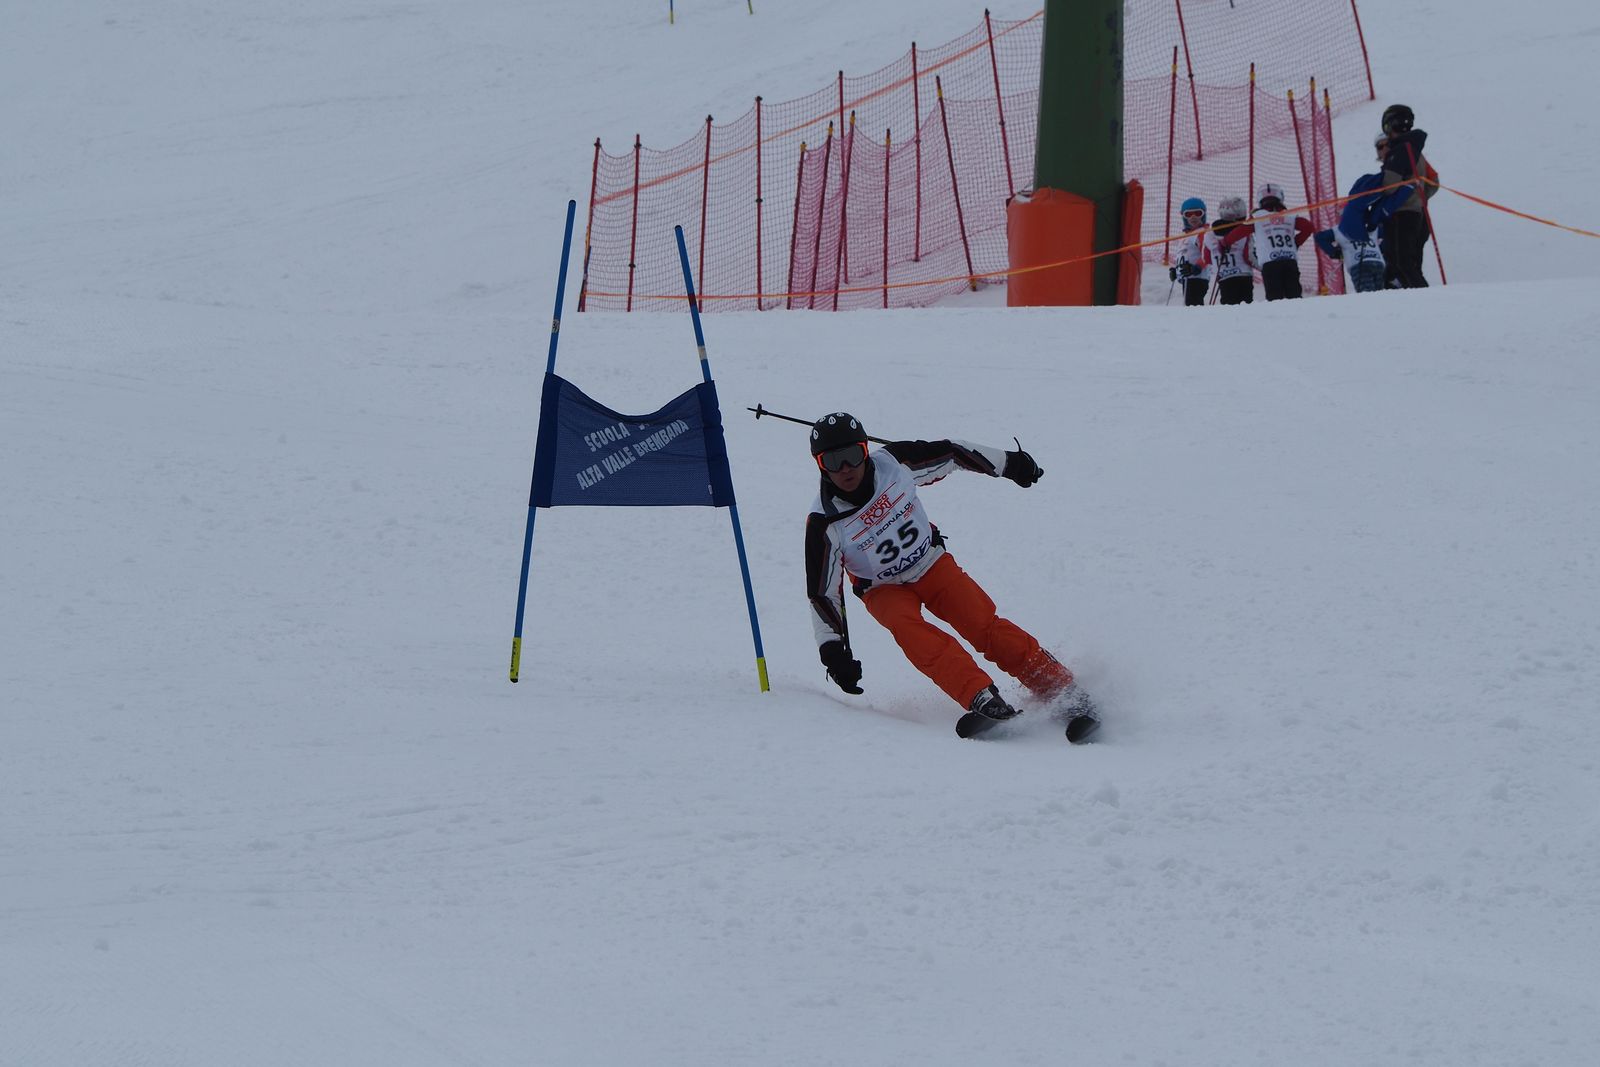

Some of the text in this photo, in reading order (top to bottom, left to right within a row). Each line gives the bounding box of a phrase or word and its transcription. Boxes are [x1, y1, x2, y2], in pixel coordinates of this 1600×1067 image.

[1267, 234, 1293, 248] 138
[1213, 253, 1236, 268] 141
[583, 421, 631, 452] SCUOLA
[576, 419, 690, 490] ALTA VALLE BREMBANA
[859, 493, 888, 520] PERICO
[863, 498, 892, 527] SPORT
[875, 501, 912, 537] BONALDI
[875, 519, 919, 565] 35
